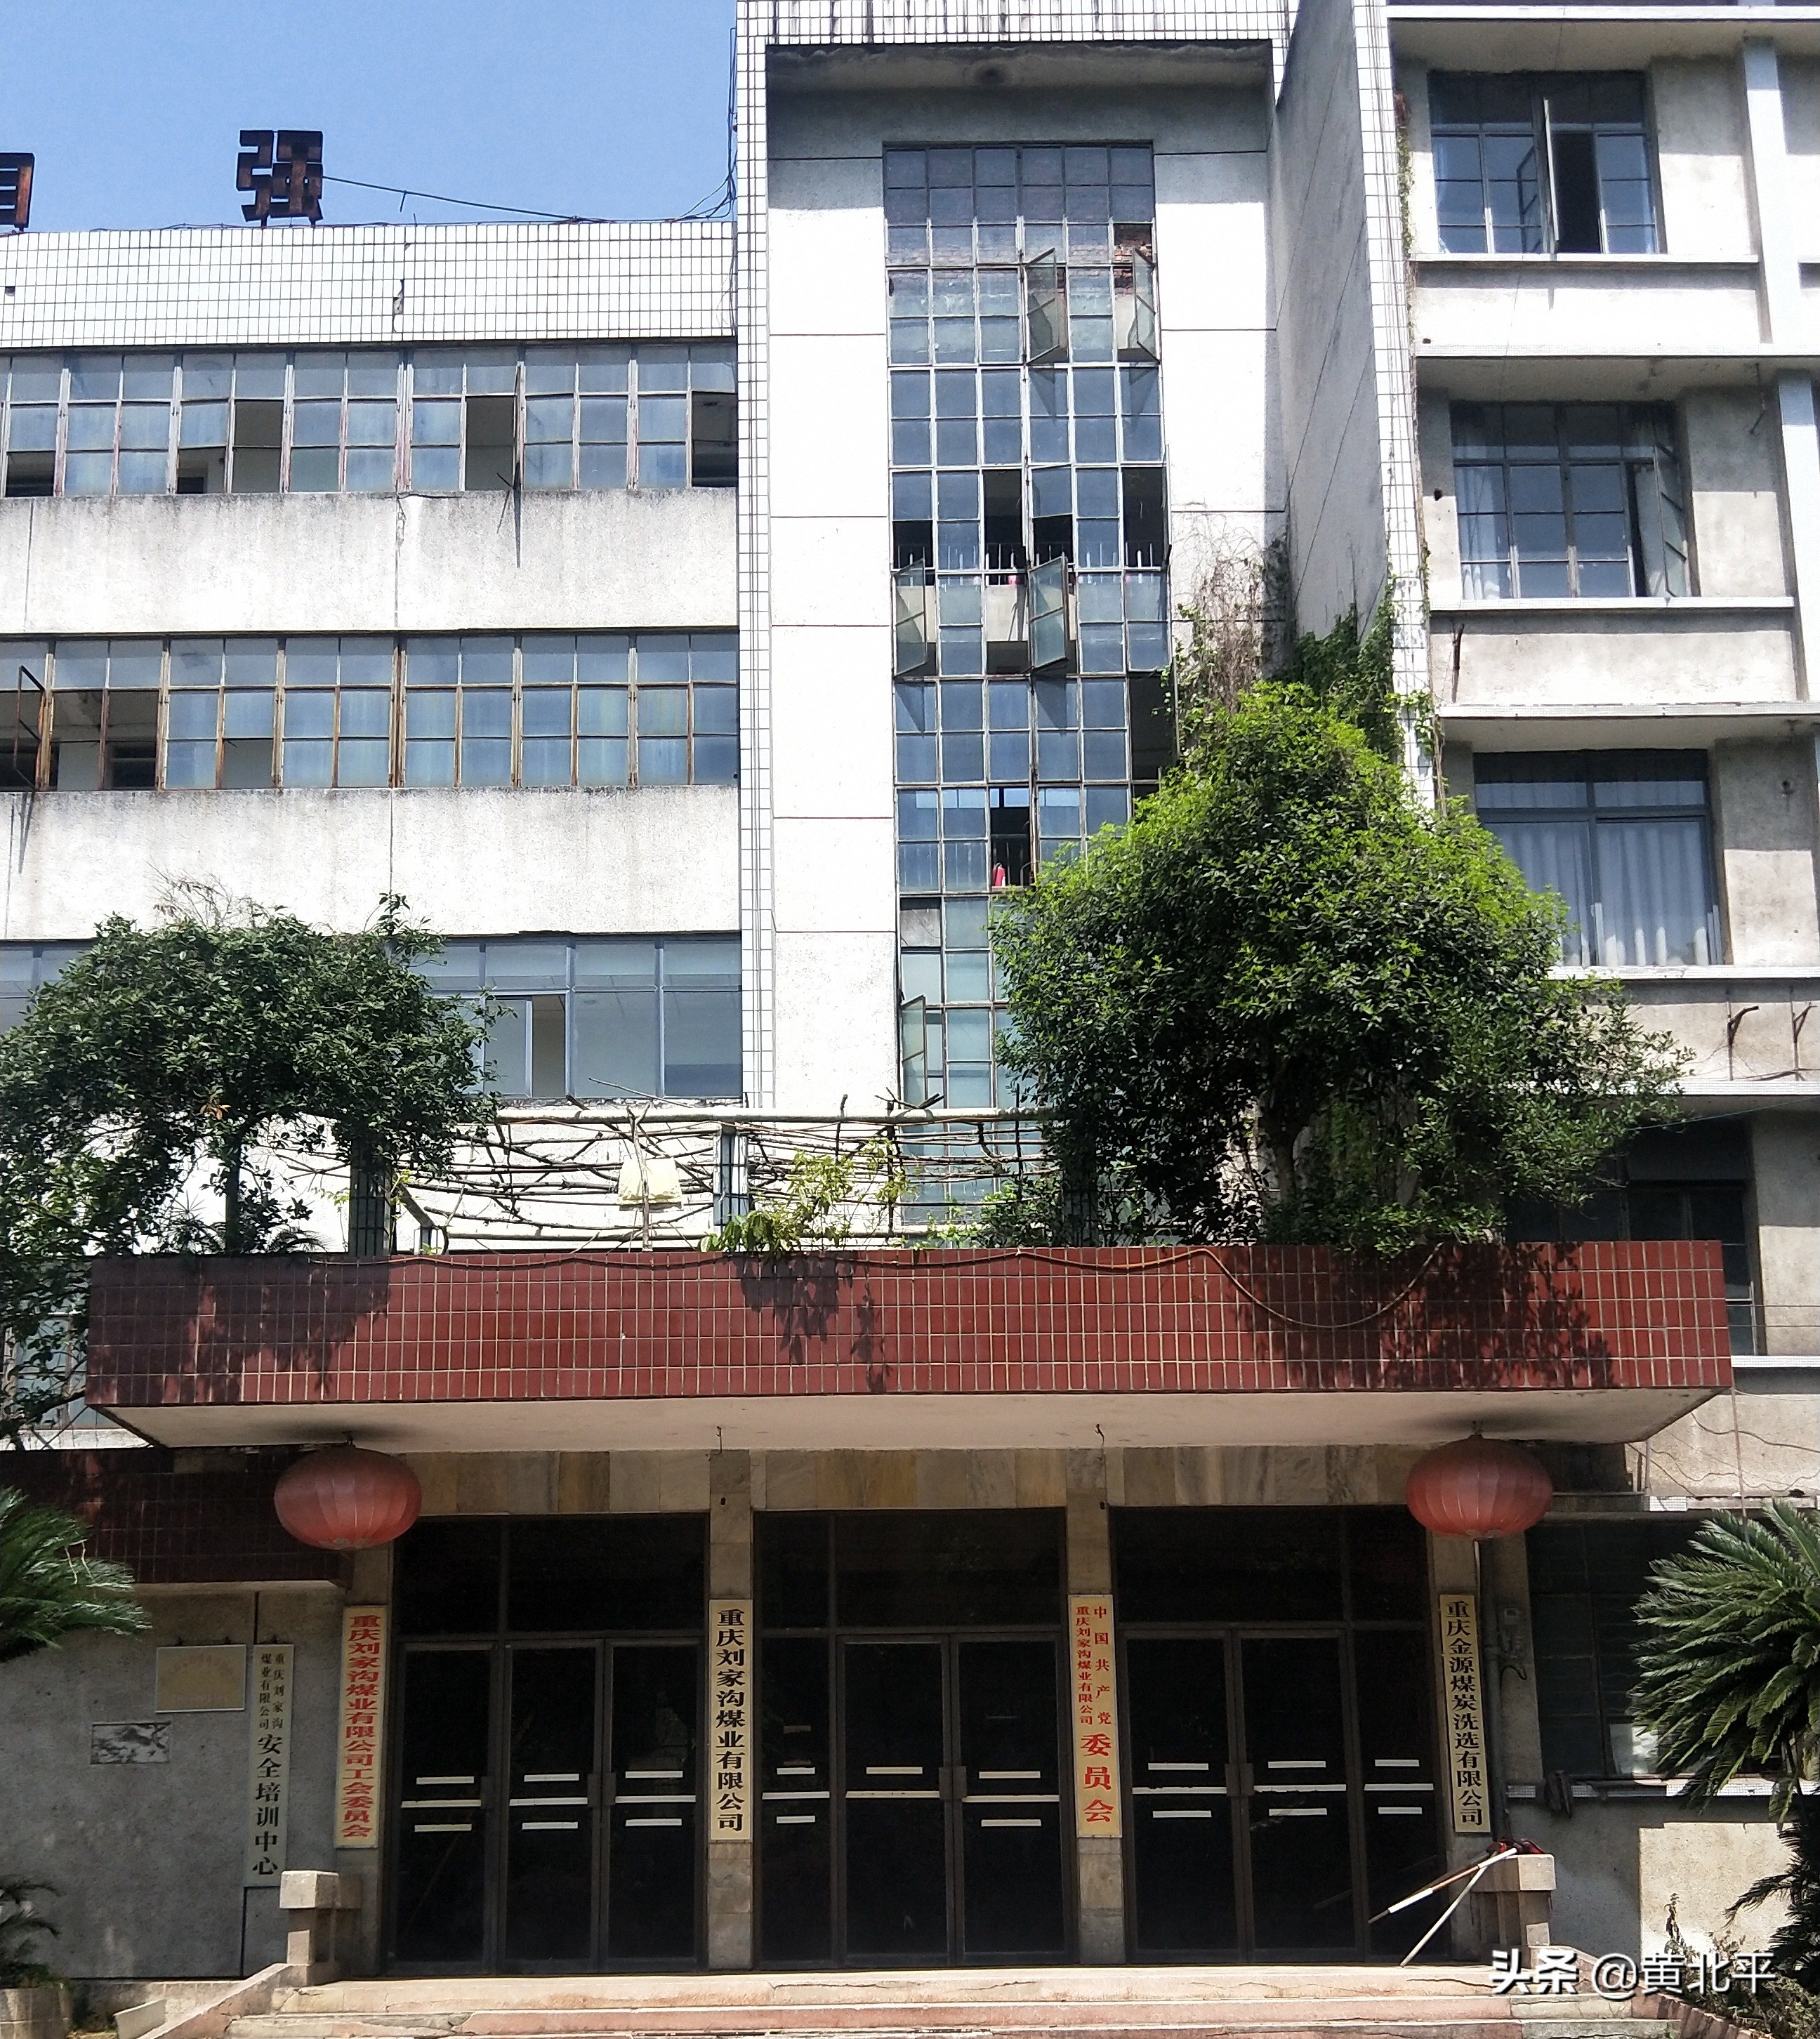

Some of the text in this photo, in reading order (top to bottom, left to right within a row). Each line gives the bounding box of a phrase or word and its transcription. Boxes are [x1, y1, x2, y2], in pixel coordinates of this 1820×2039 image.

[236, 129, 323, 222] 强
[258, 1653, 272, 1730] 煤业有限公司
[272, 1653, 285, 1730] 重庆刘家沟
[715, 1608, 746, 1832] 重庆刘家沟煤业有限公司
[1075, 1605, 1093, 1726] 重庆刘家沟煤业有限公司
[1093, 1606, 1112, 1725] 中国共产党
[1446, 1600, 1483, 1826] 重庆金源煤炭洗选有限公司
[341, 1614, 381, 1838] 重庆刘家沟煤业有限公司工会委员会
[1081, 1733, 1114, 1823] 委员会
[251, 1733, 284, 1876] 安全培训中心
